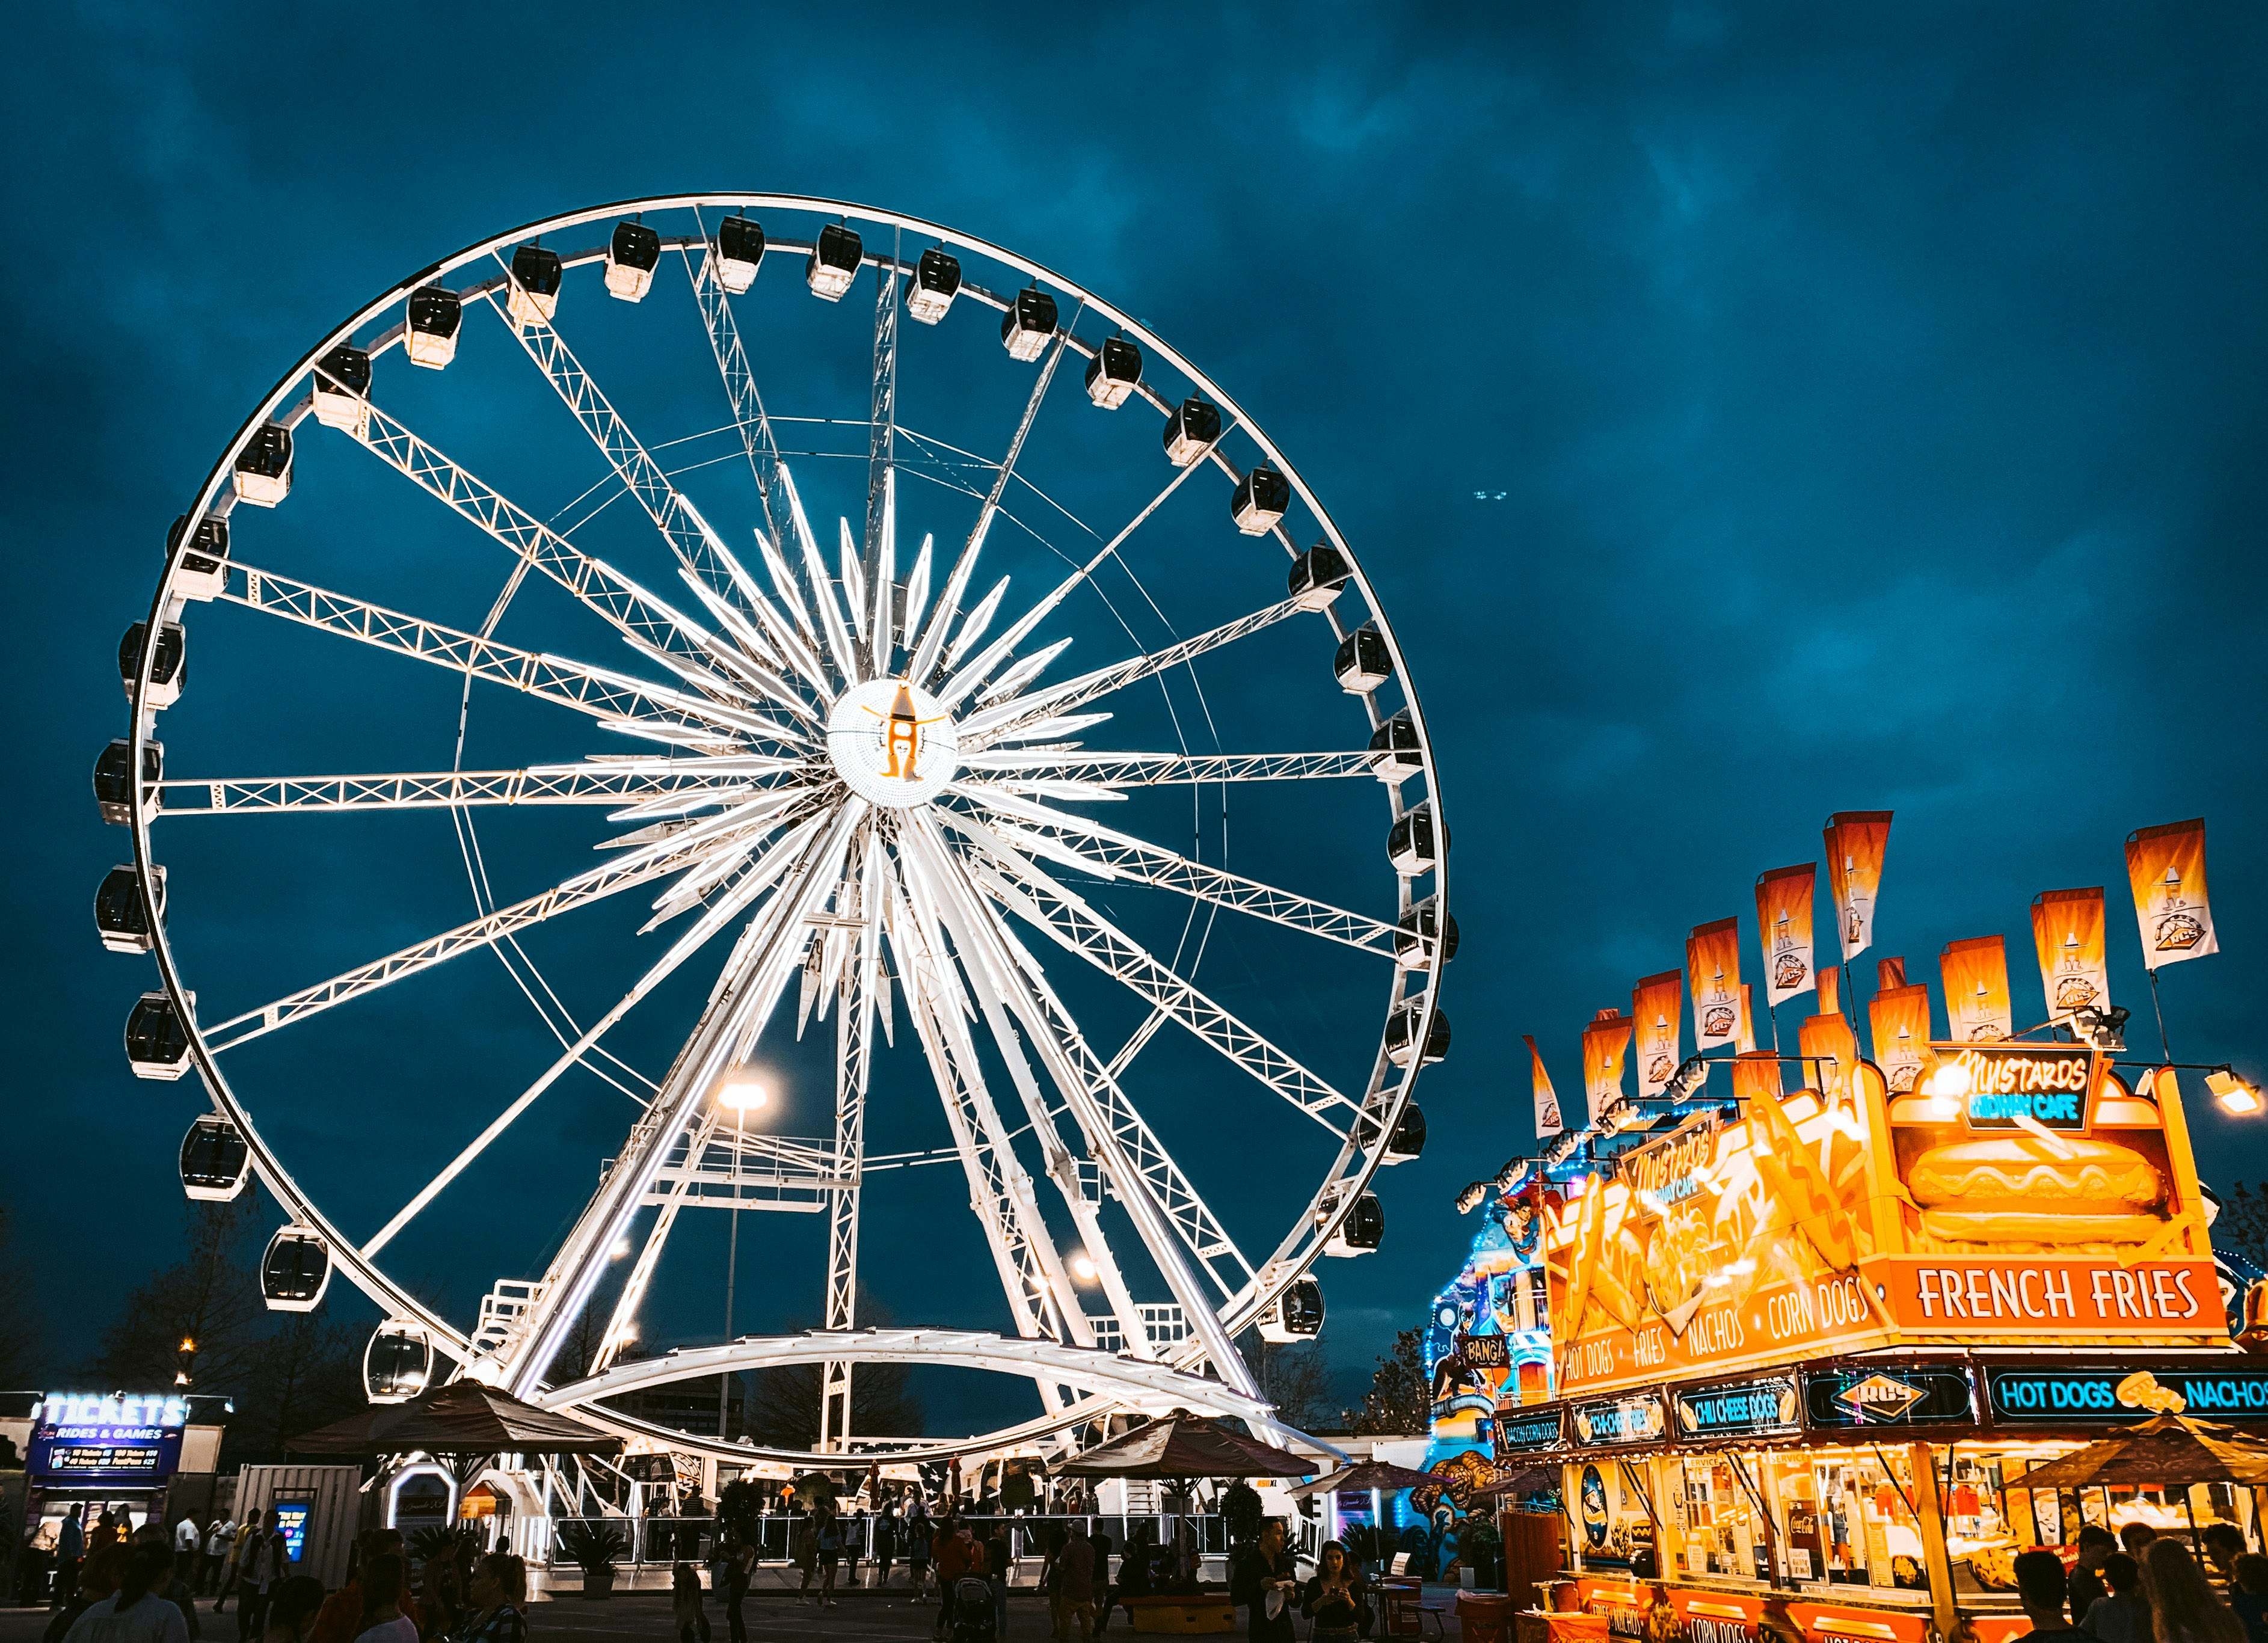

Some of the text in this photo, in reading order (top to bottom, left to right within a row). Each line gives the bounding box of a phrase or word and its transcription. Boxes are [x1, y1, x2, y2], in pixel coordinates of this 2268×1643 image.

[2170, 930, 2198, 944] RCS
[2065, 991, 2092, 1005] RCS
[1969, 1094, 2079, 1120] MIDWAY CAFE
[1918, 1269, 2199, 1319] FRENCH FRIES
[1565, 1275, 1869, 1382] HOT DOGS FRIES NACHOS CORN DOGS
[1467, 1339, 1503, 1363] BANG!
[1860, 1385, 1912, 1402] RCS
[2001, 1381, 2047, 1408] HOT
[2051, 1381, 2115, 1408] DOGS
[43, 1393, 186, 1427] TICKETS
[1695, 1393, 1778, 1425] CHILI CHEESE DOGS
[56, 1428, 97, 1439] RIDES
[99, 1429, 110, 1439] &
[112, 1428, 162, 1440] GAMES
[1526, 1423, 1541, 1442] CORN
[1541, 1422, 1559, 1440] DOGS
[1686, 1458, 1719, 1467] SERVICE
[1771, 1454, 1807, 1463] SERVICE
[1613, 1606, 1641, 1635] NACHOS
[1691, 1617, 1717, 1643] CORN
